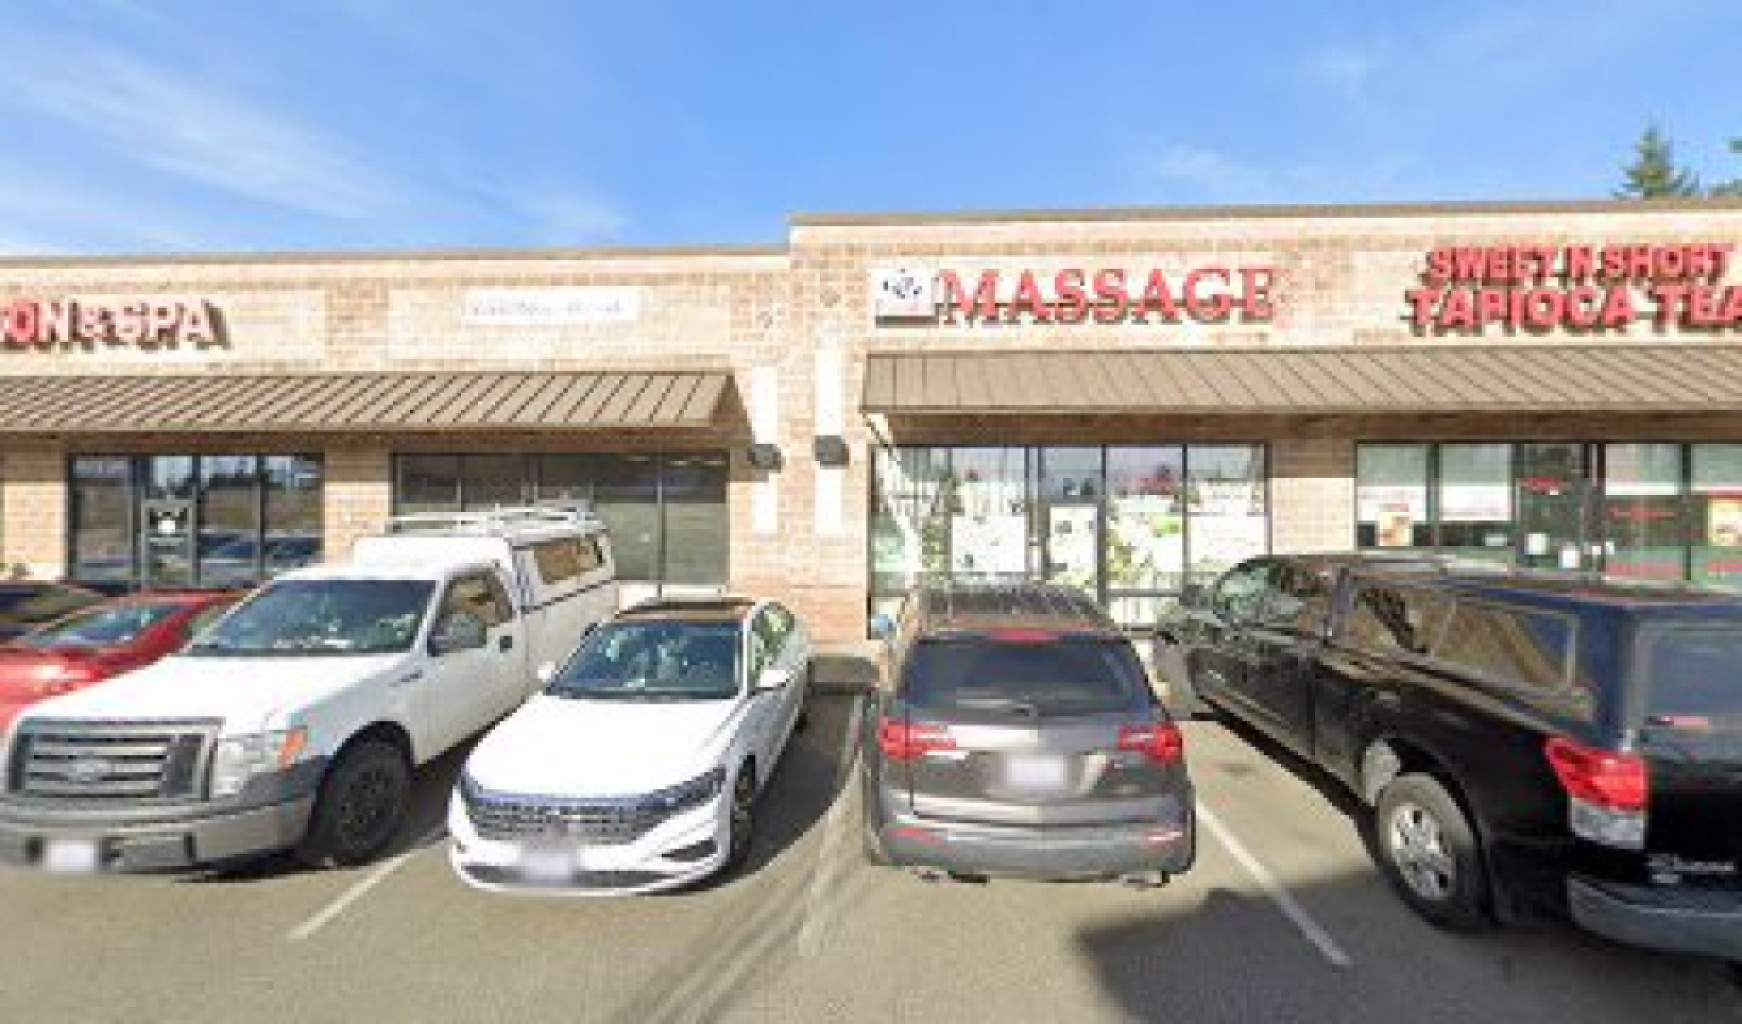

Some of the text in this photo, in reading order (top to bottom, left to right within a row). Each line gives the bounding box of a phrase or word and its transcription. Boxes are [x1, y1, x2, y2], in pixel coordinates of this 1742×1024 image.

[938, 267, 1276, 325] MASSAGE
[1408, 287, 1634, 328] TAPIOCA
[0, 299, 74, 344] ON
[114, 298, 226, 346] SPA
